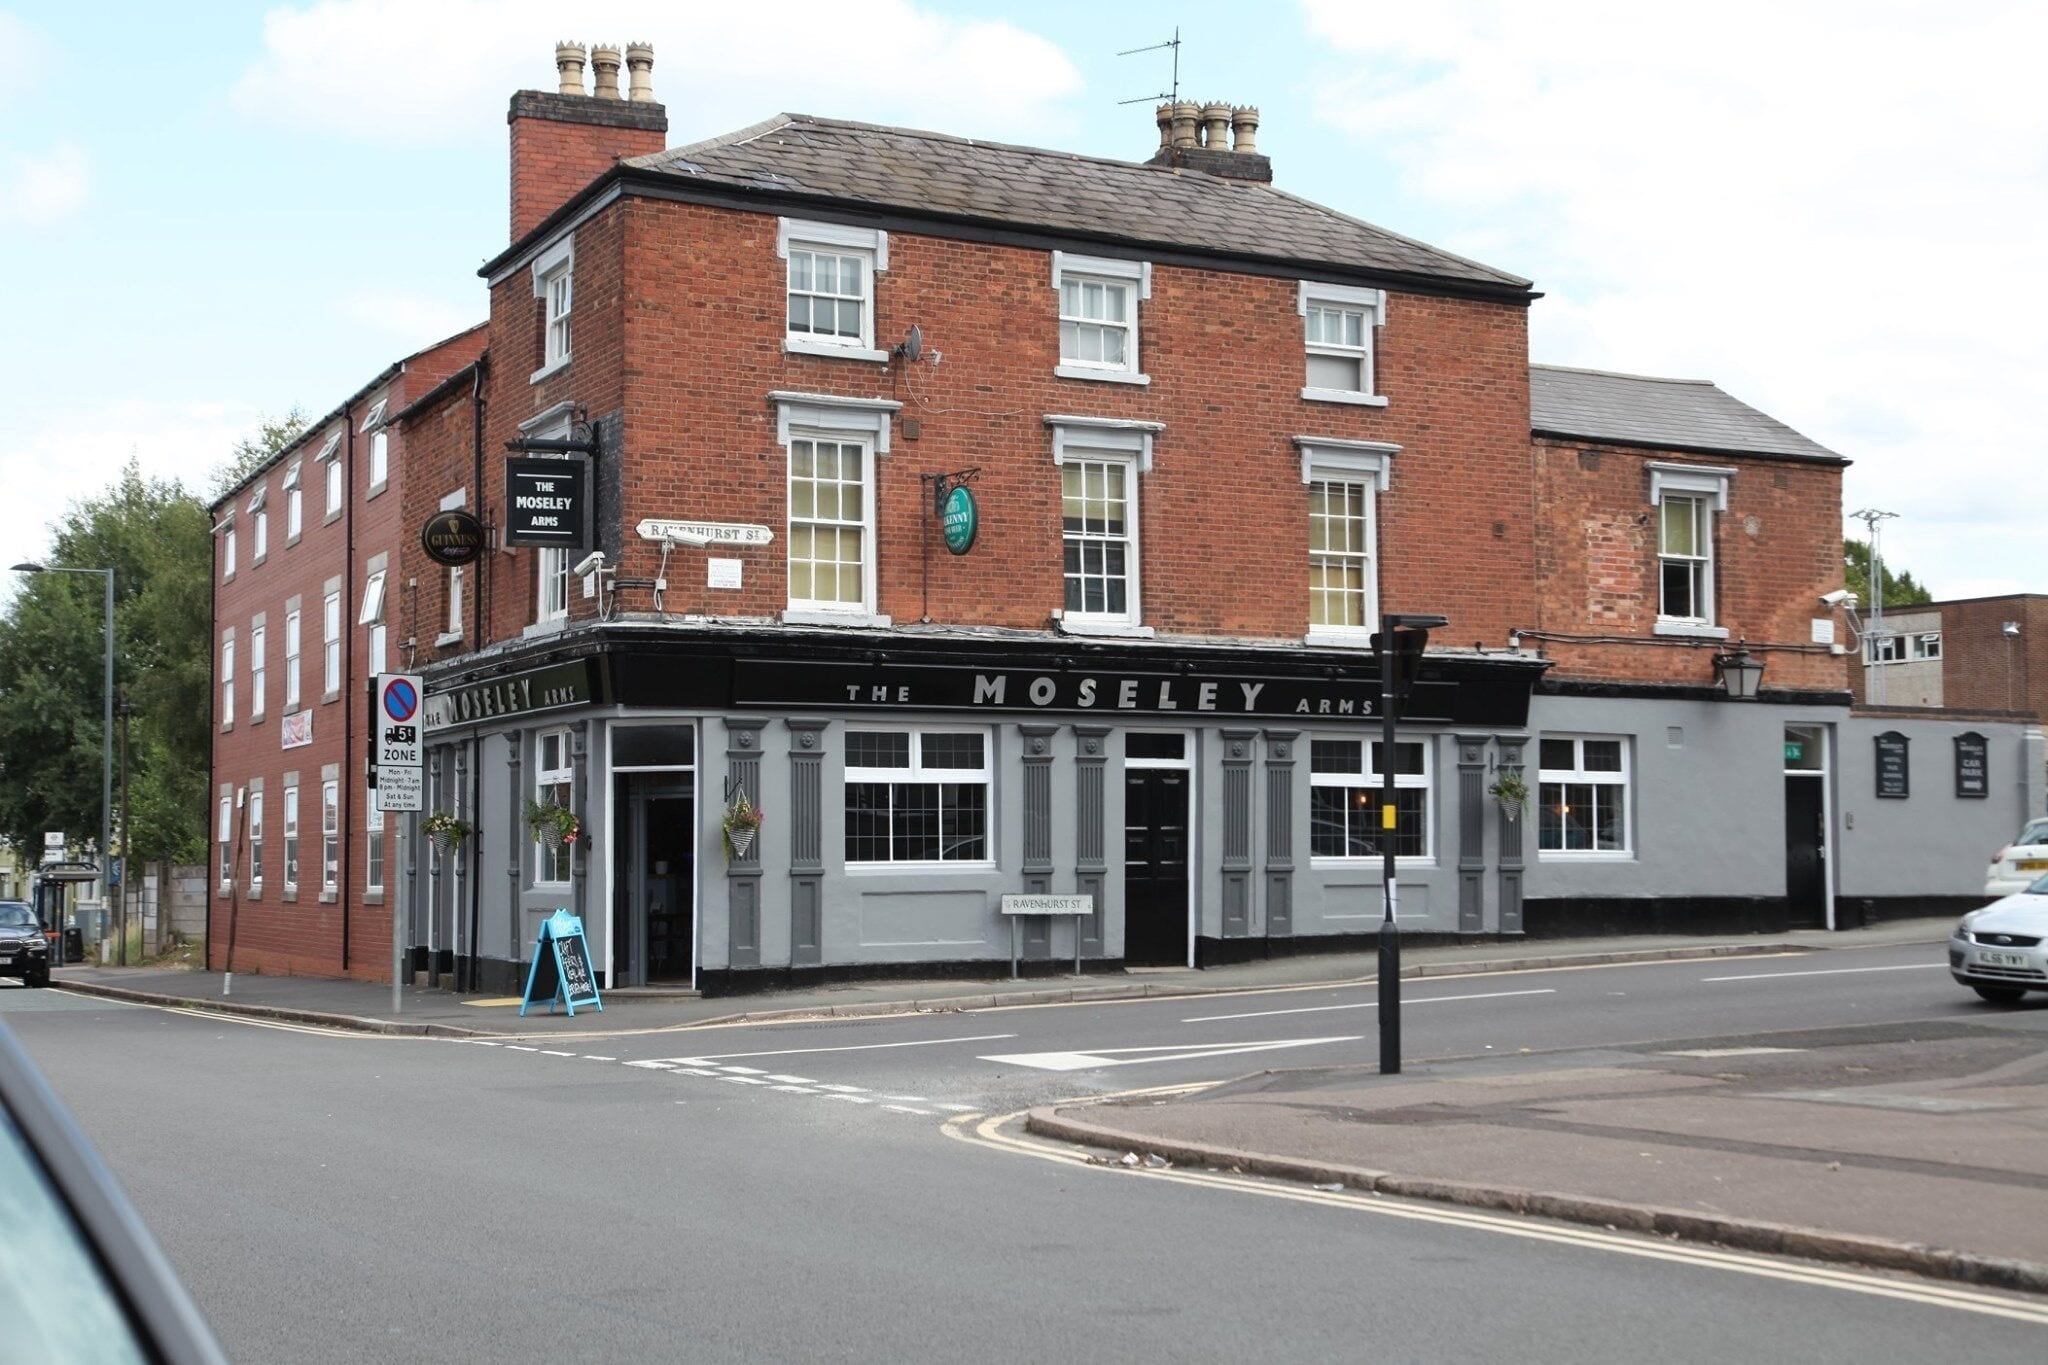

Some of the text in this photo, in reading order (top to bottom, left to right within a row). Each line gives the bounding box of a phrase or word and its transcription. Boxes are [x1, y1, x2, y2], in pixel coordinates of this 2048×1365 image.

[535, 481, 555, 492] THE
[516, 496, 572, 510] MOSELEY
[531, 516, 559, 527] ARMS
[651, 524, 740, 540] RANHURST
[447, 679, 532, 723] MOSELEY
[544, 685, 576, 706] ARMS
[847, 675, 1373, 715] THE MOSELEY ARMS
[384, 749, 416, 761] ZONE
[1963, 759, 1981, 768] CAR
[1013, 899, 1069, 908] RAVENHURST
[1071, 899, 1081, 908] ST
